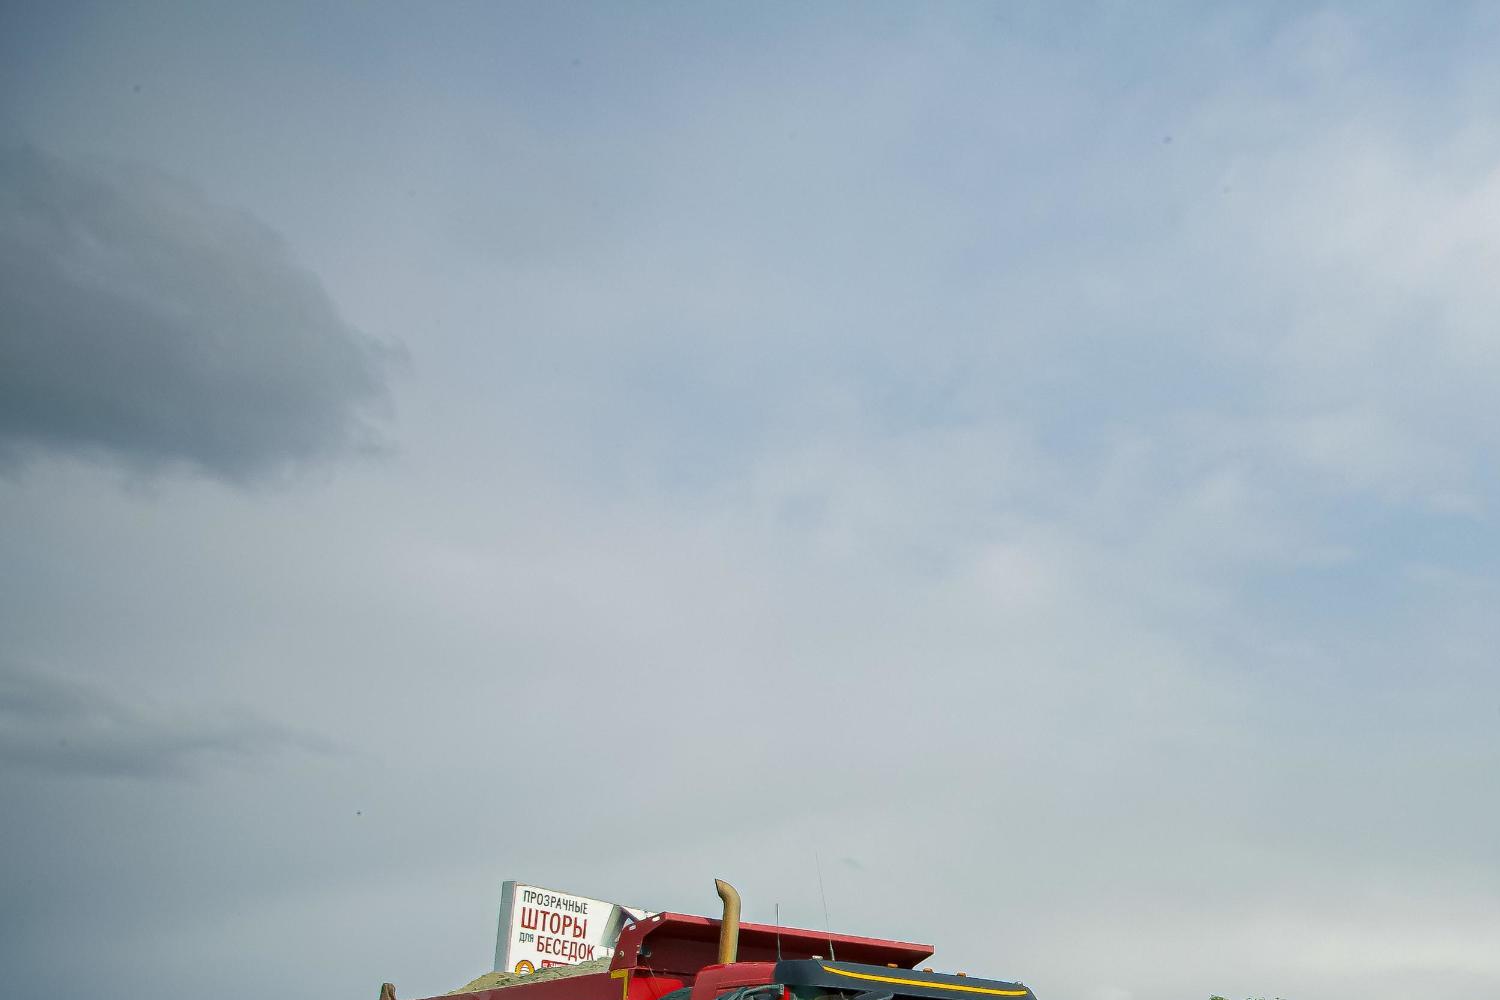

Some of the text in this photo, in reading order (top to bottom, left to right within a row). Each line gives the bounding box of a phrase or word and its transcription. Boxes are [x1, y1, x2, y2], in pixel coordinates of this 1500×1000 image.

[523, 890, 589, 915] ПРОЗРАЧНЫЕ
[520, 906, 588, 939] ШТОРЫ
[536, 935, 595, 961] БЕСЕДОК
